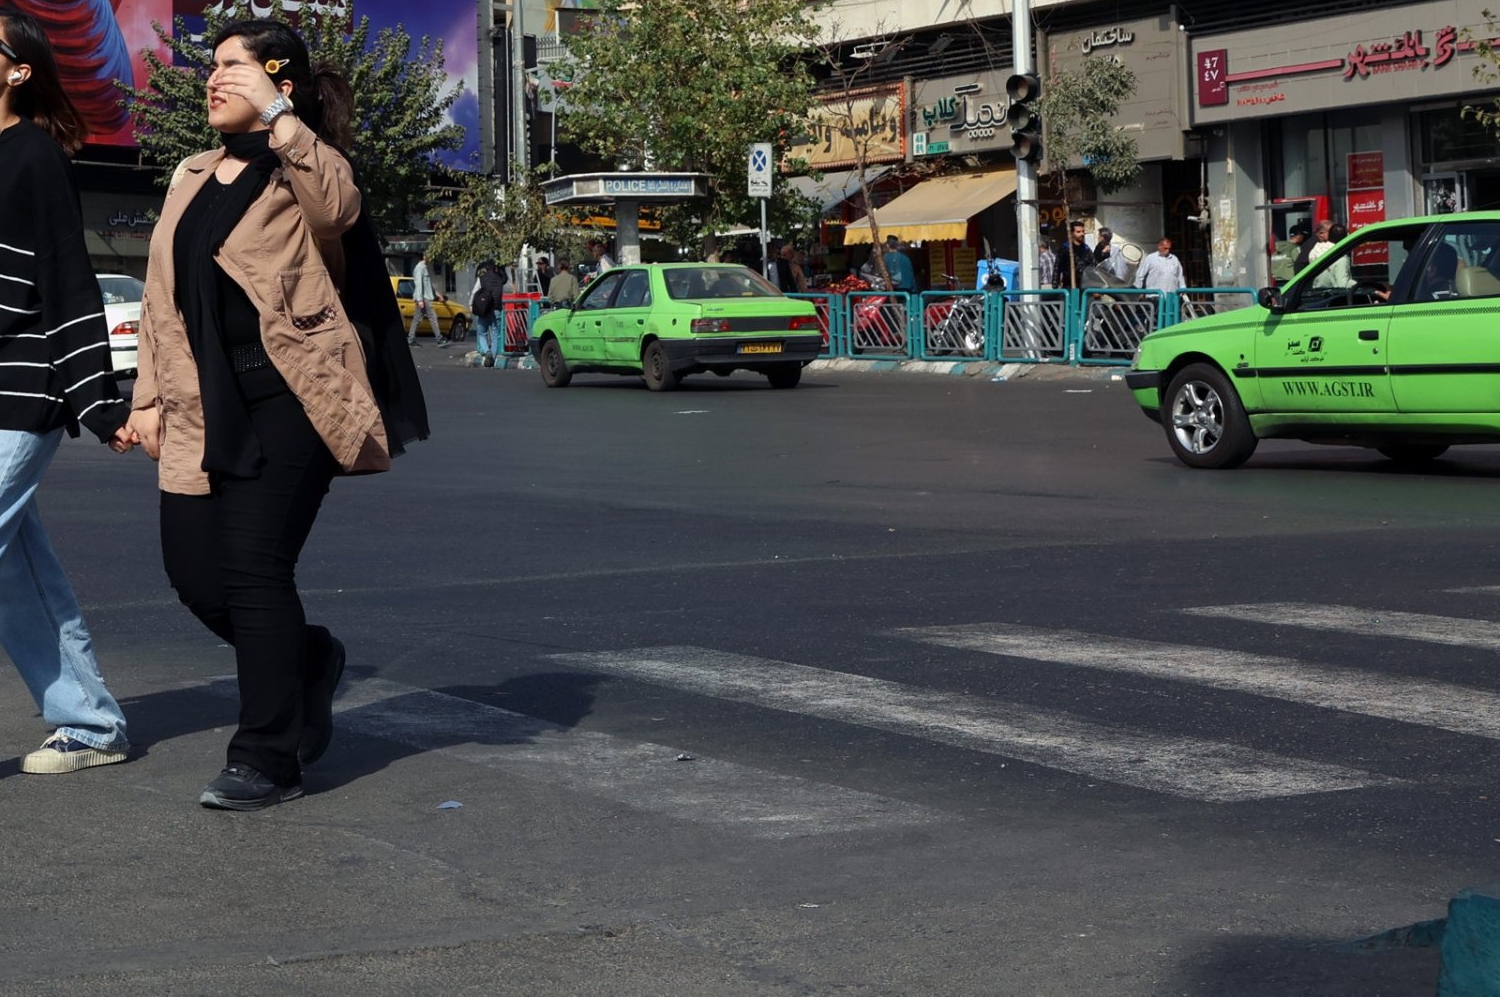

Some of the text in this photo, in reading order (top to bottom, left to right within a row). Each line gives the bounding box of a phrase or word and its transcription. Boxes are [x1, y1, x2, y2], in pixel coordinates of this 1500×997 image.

[1081, 28, 1133, 53] ساختمان
[1204, 57, 1219, 69] 47
[605, 180, 646, 192] POLICE
[1282, 381, 1375, 398] WWW.AGST.IR
